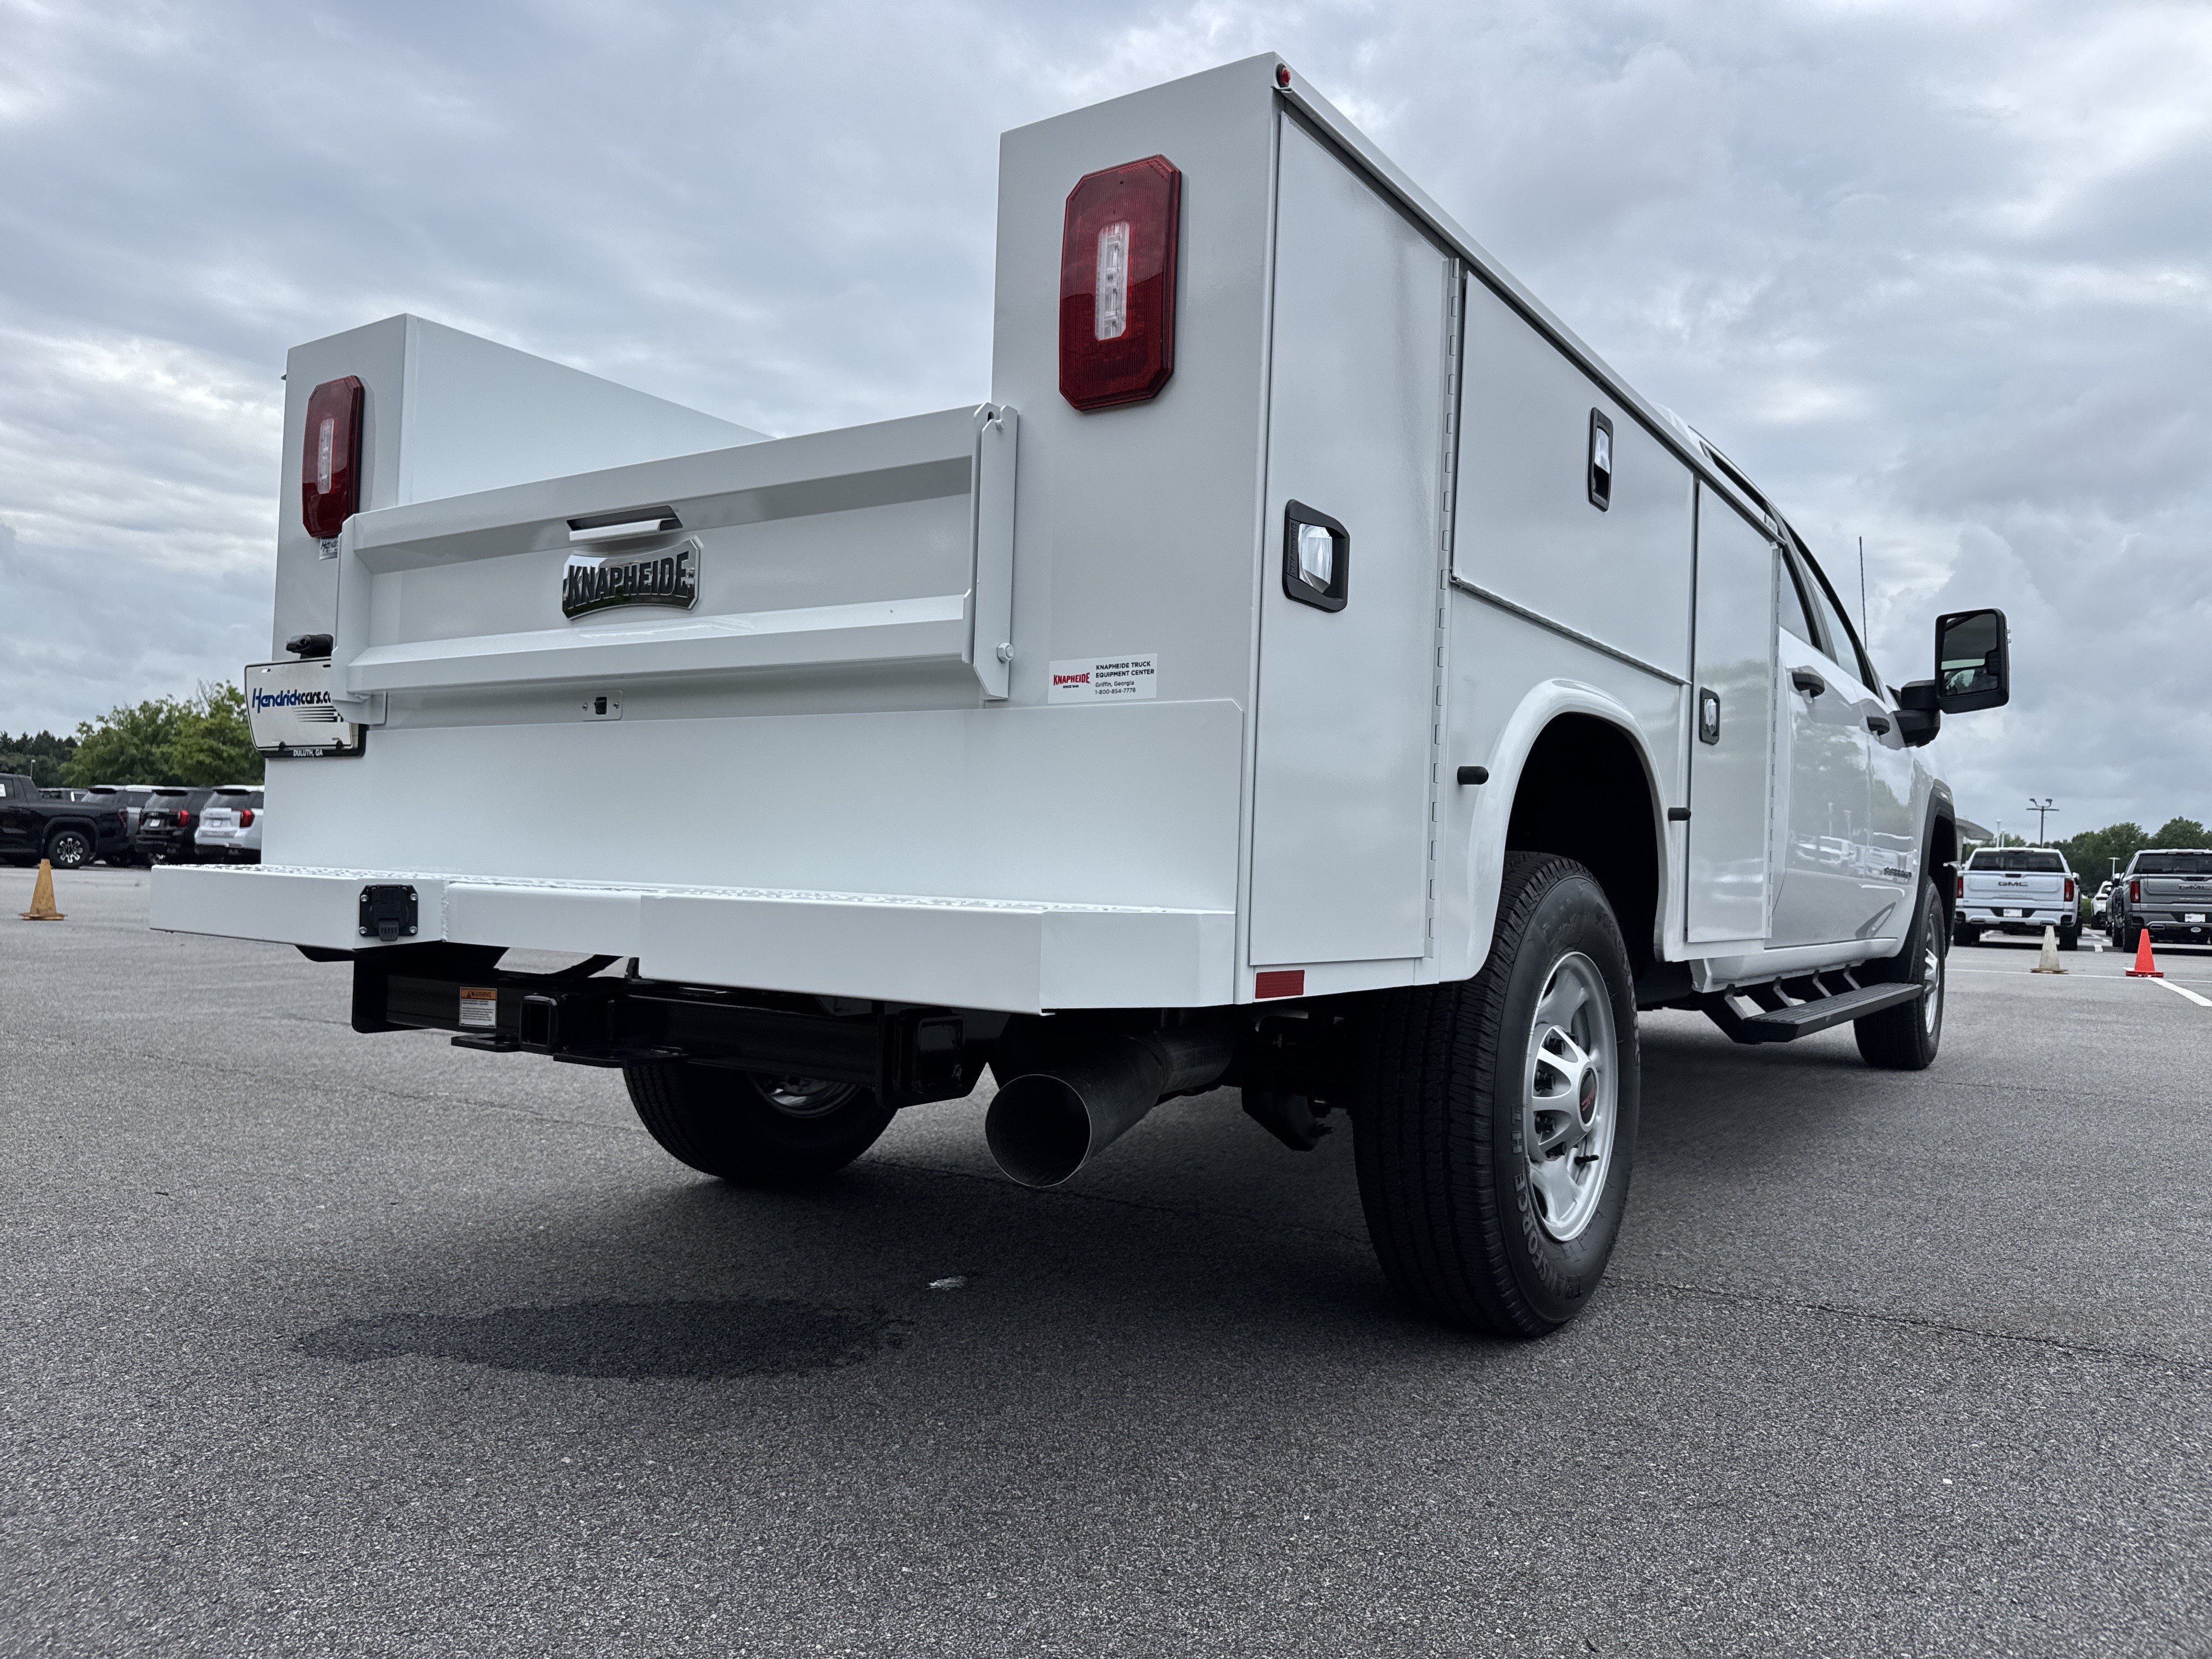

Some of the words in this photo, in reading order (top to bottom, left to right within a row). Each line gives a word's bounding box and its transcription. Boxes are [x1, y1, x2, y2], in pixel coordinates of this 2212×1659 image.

[567, 551, 690, 610] KNAPHEIDE
[1096, 662, 1130, 670] KNAPHEIDE
[1053, 672, 1090, 686] KNAPHEIDE
[293, 749, 314, 758] DULUTH,
[1510, 1105, 1523, 1154] HT
